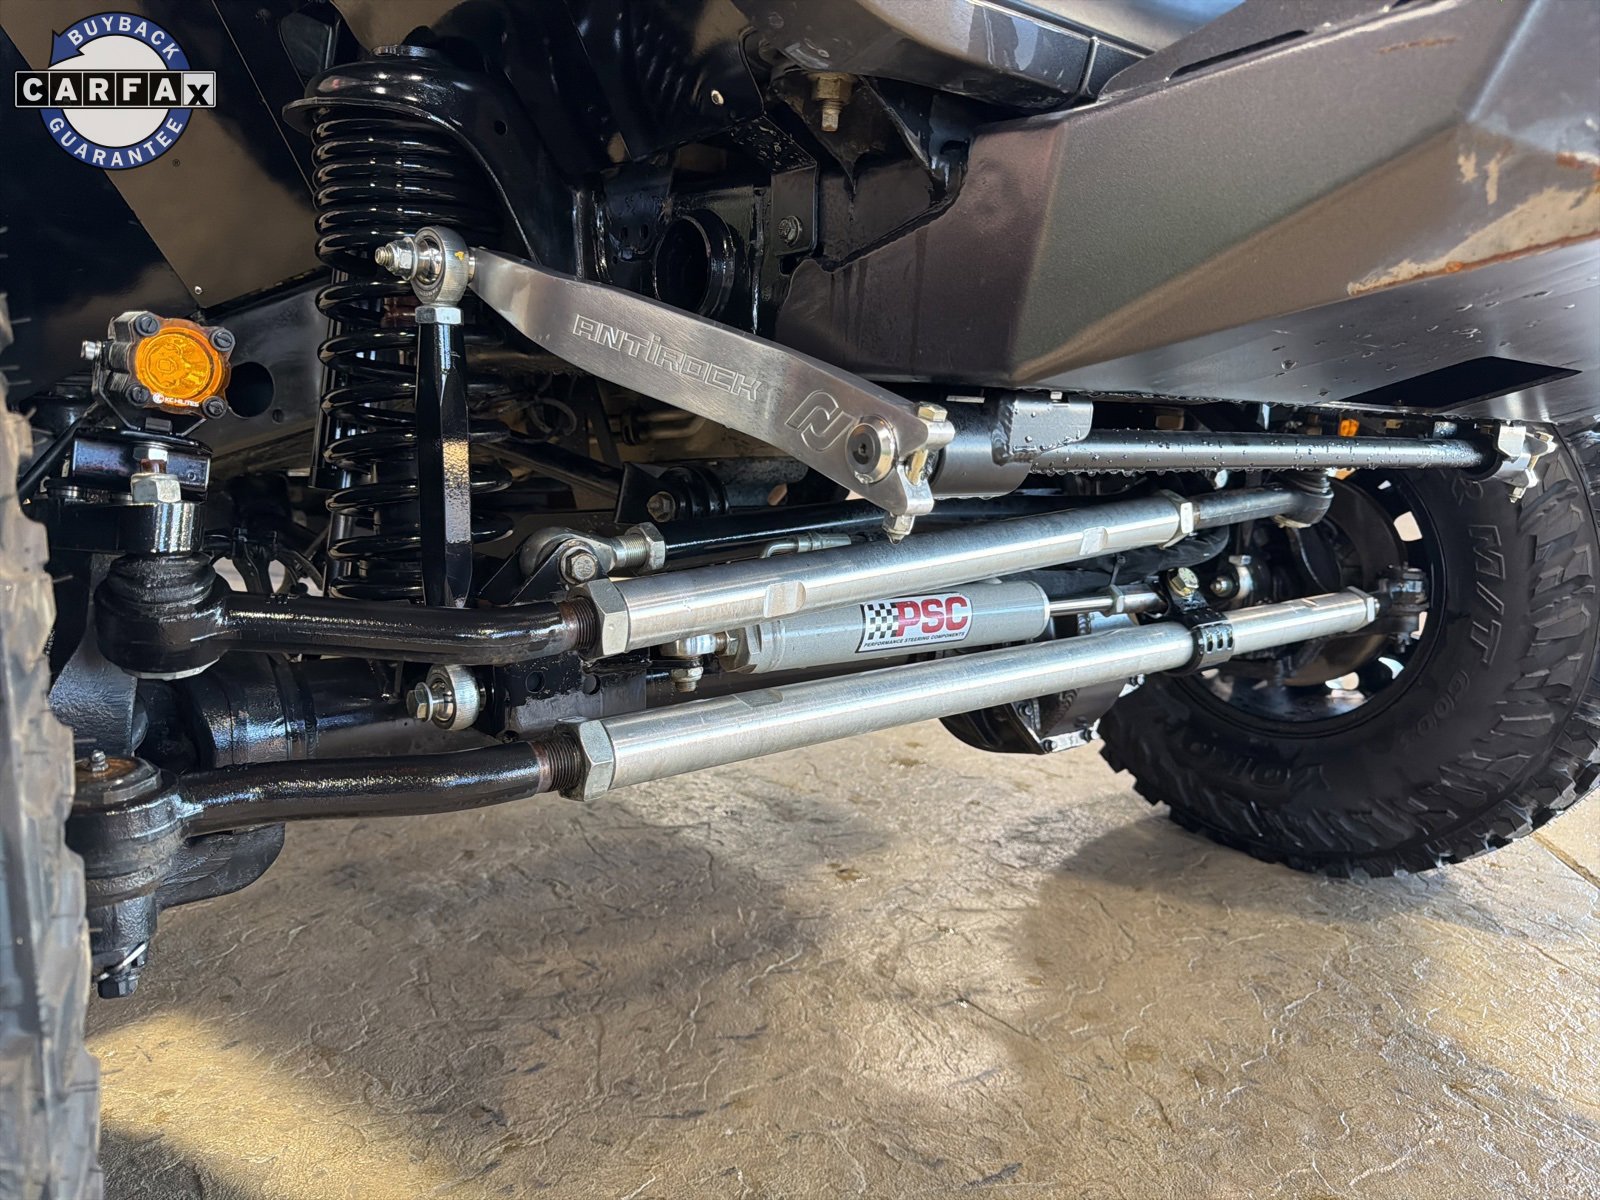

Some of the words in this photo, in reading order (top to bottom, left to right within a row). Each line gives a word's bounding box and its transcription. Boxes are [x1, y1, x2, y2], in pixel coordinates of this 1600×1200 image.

[895, 596, 968, 637] PSC
[864, 639, 903, 647] PERFORMANCE
[931, 632, 965, 640] COMPONENTS
